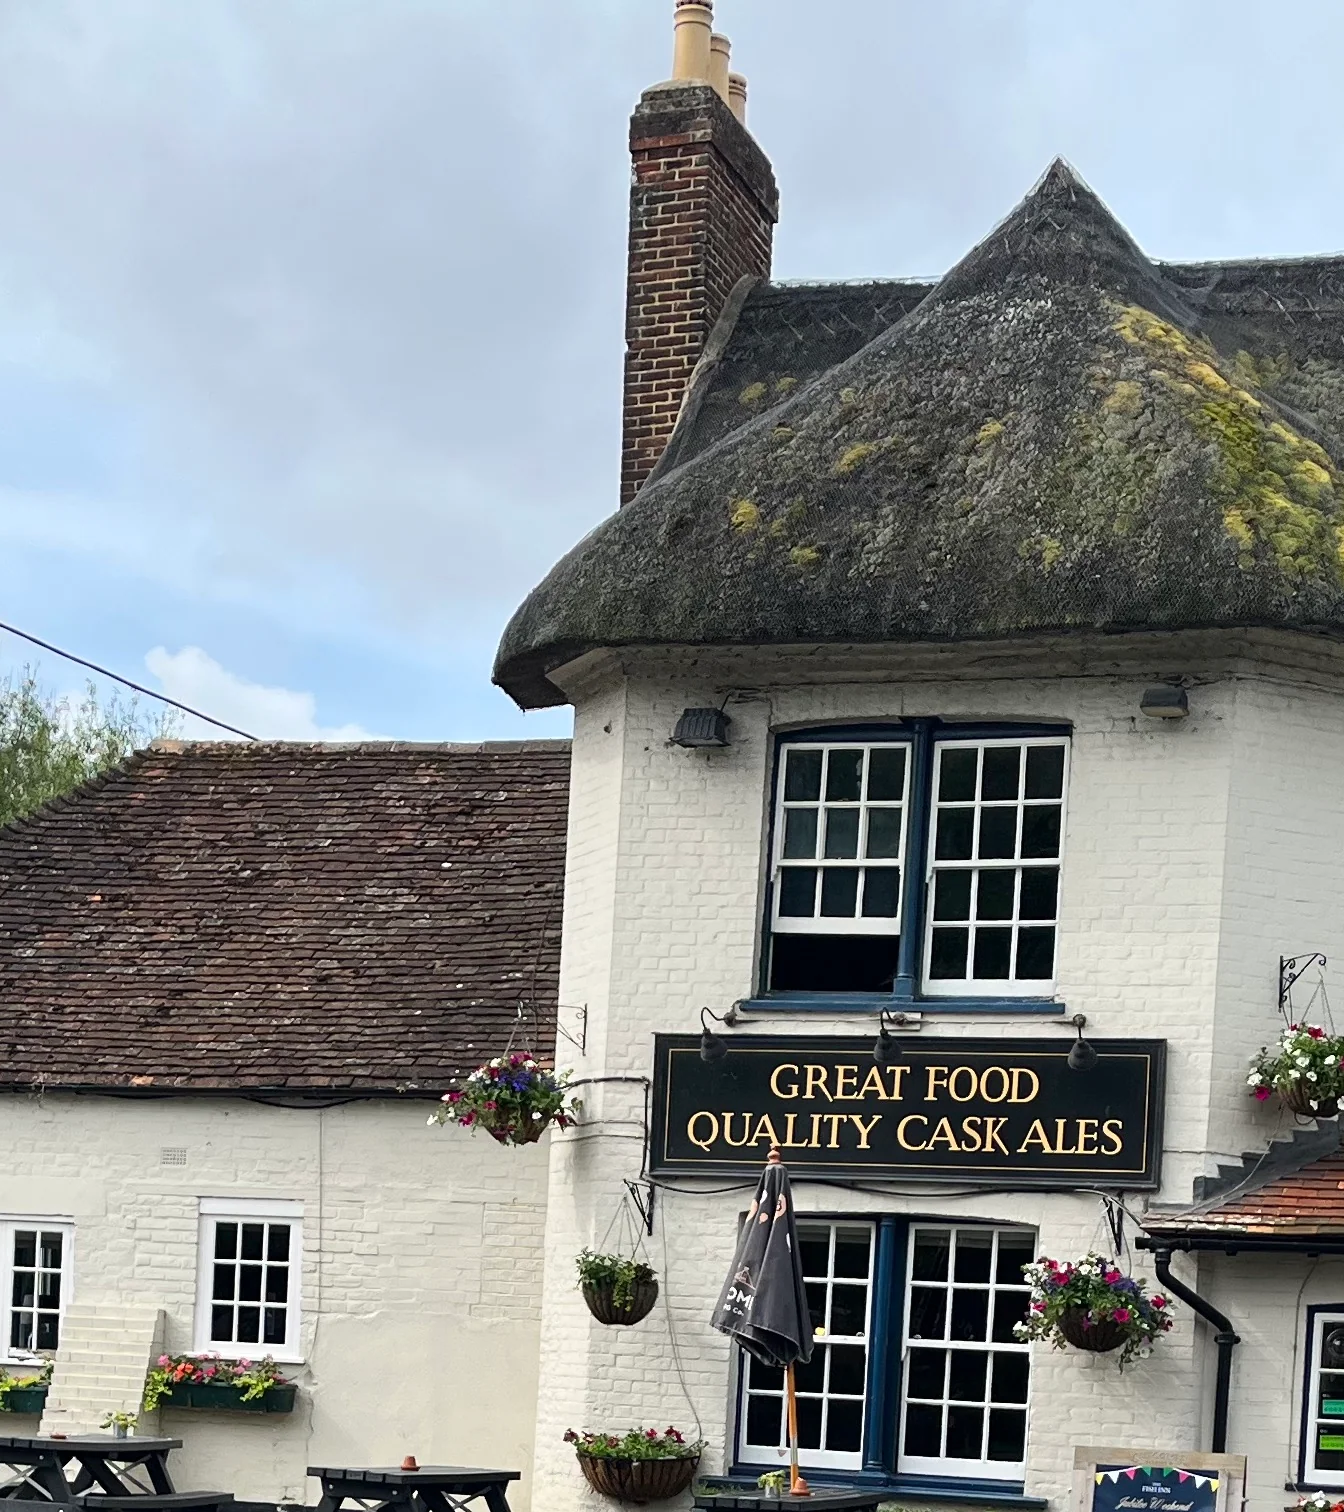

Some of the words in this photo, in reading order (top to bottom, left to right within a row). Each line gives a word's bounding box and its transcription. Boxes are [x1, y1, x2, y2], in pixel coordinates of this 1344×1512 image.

[770, 1063, 910, 1102] GREAT
[923, 1066, 1040, 1103] FOOD
[687, 1110, 882, 1152] QUALITY
[897, 1114, 1010, 1156] CASK
[1017, 1118, 1124, 1155] ALES
[1149, 1497, 1194, 1511] Weekend
